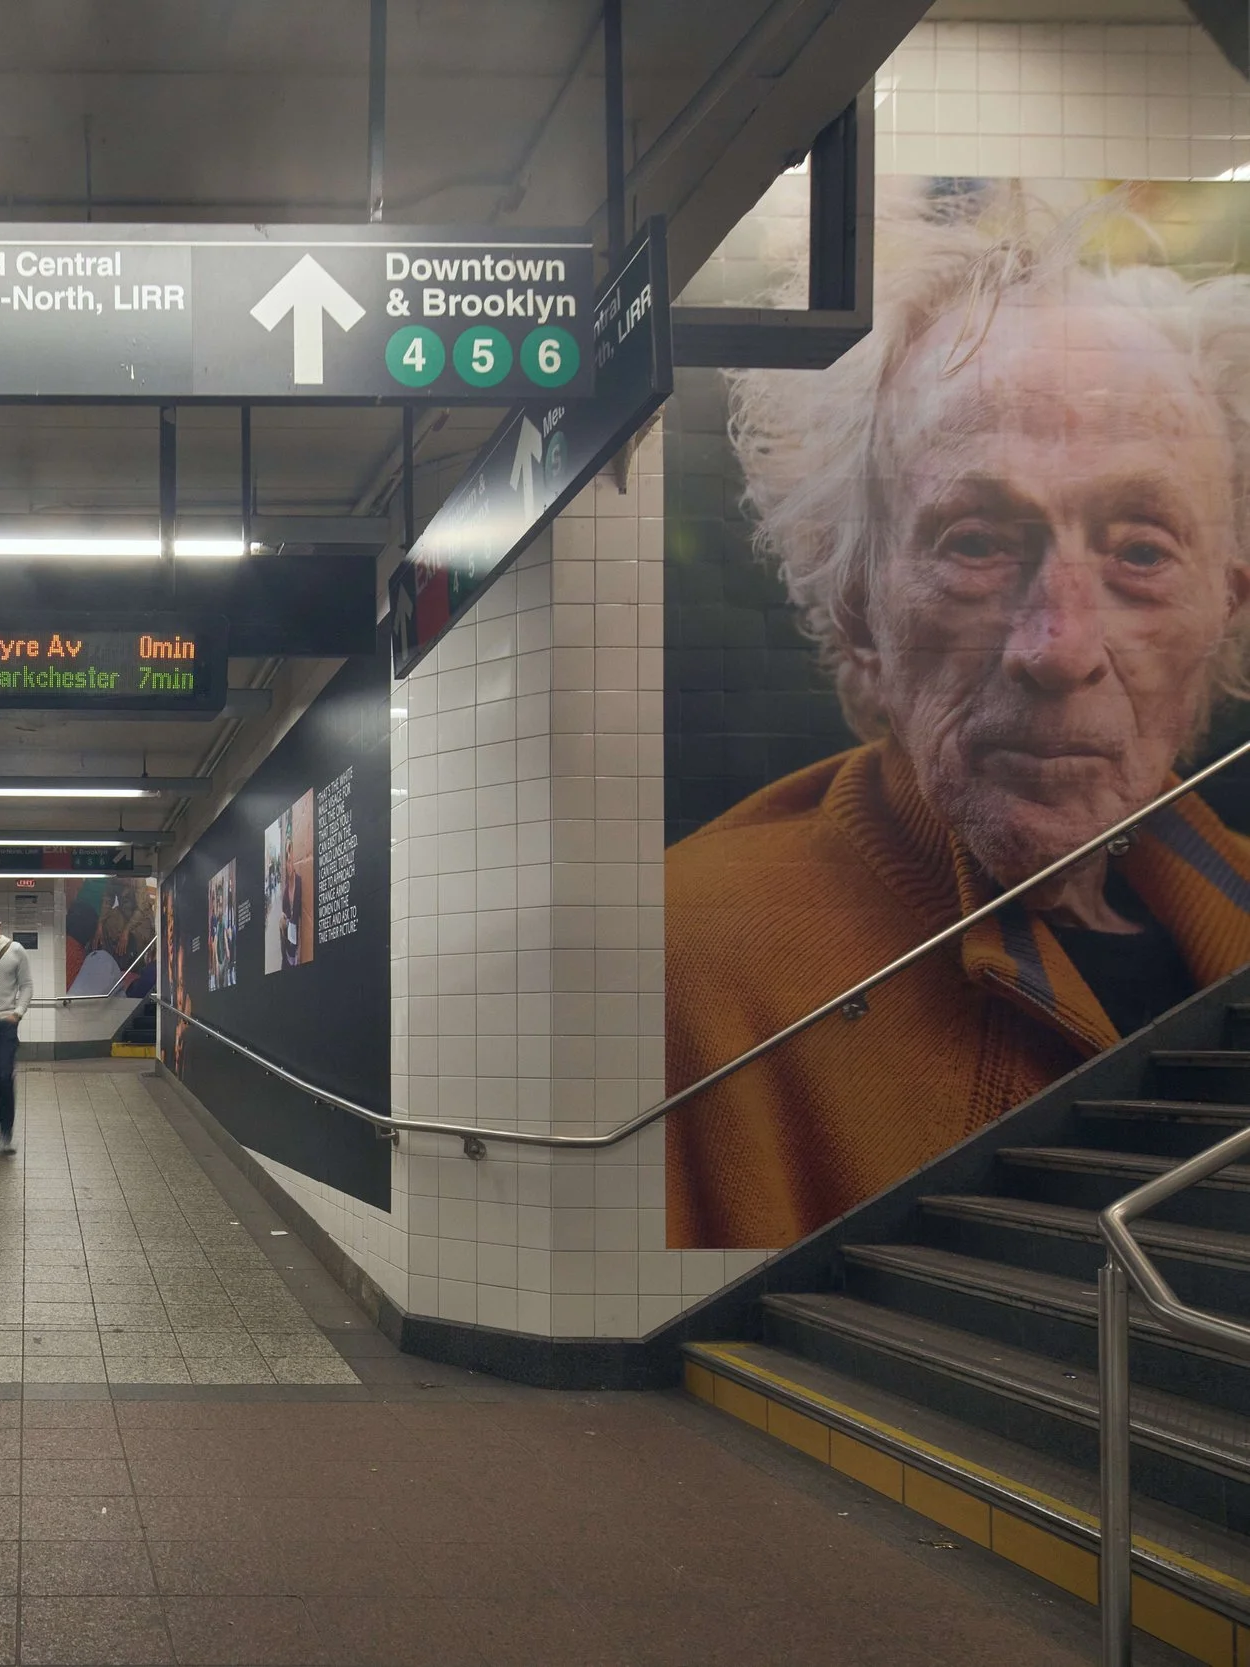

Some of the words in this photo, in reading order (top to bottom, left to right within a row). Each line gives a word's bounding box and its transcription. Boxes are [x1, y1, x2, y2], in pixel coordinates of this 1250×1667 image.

[15, 251, 122, 278] Central
[385, 252, 566, 283] Downtown
[114, 284, 185, 311] LIRR
[386, 287, 412, 318] &
[422, 287, 577, 324] Brooklyn
[617, 283, 652, 344] LIRR
[47, 634, 82, 657] Av
[140, 635, 195, 659] 0min
[139, 666, 194, 689] 7min
[330, 777, 339, 794] THE
[327, 807, 335, 823] THE
[335, 800, 344, 817] ONE
[318, 839, 327, 855] CAN
[337, 828, 342, 843] IN
[343, 823, 351, 839] THE
[318, 878, 327, 893] FREE
[327, 875, 332, 888] TO
[333, 863, 355, 885] APPROACH
[320, 863, 329, 879] CAN
[329, 859, 337, 874] FEEL
[318, 887, 335, 906] STRANGE
[336, 879, 350, 897] ARMED
[333, 898, 340, 912] ON
[340, 894, 348, 909] THE
[332, 911, 341, 926] AND
[349, 904, 356, 919] TO
